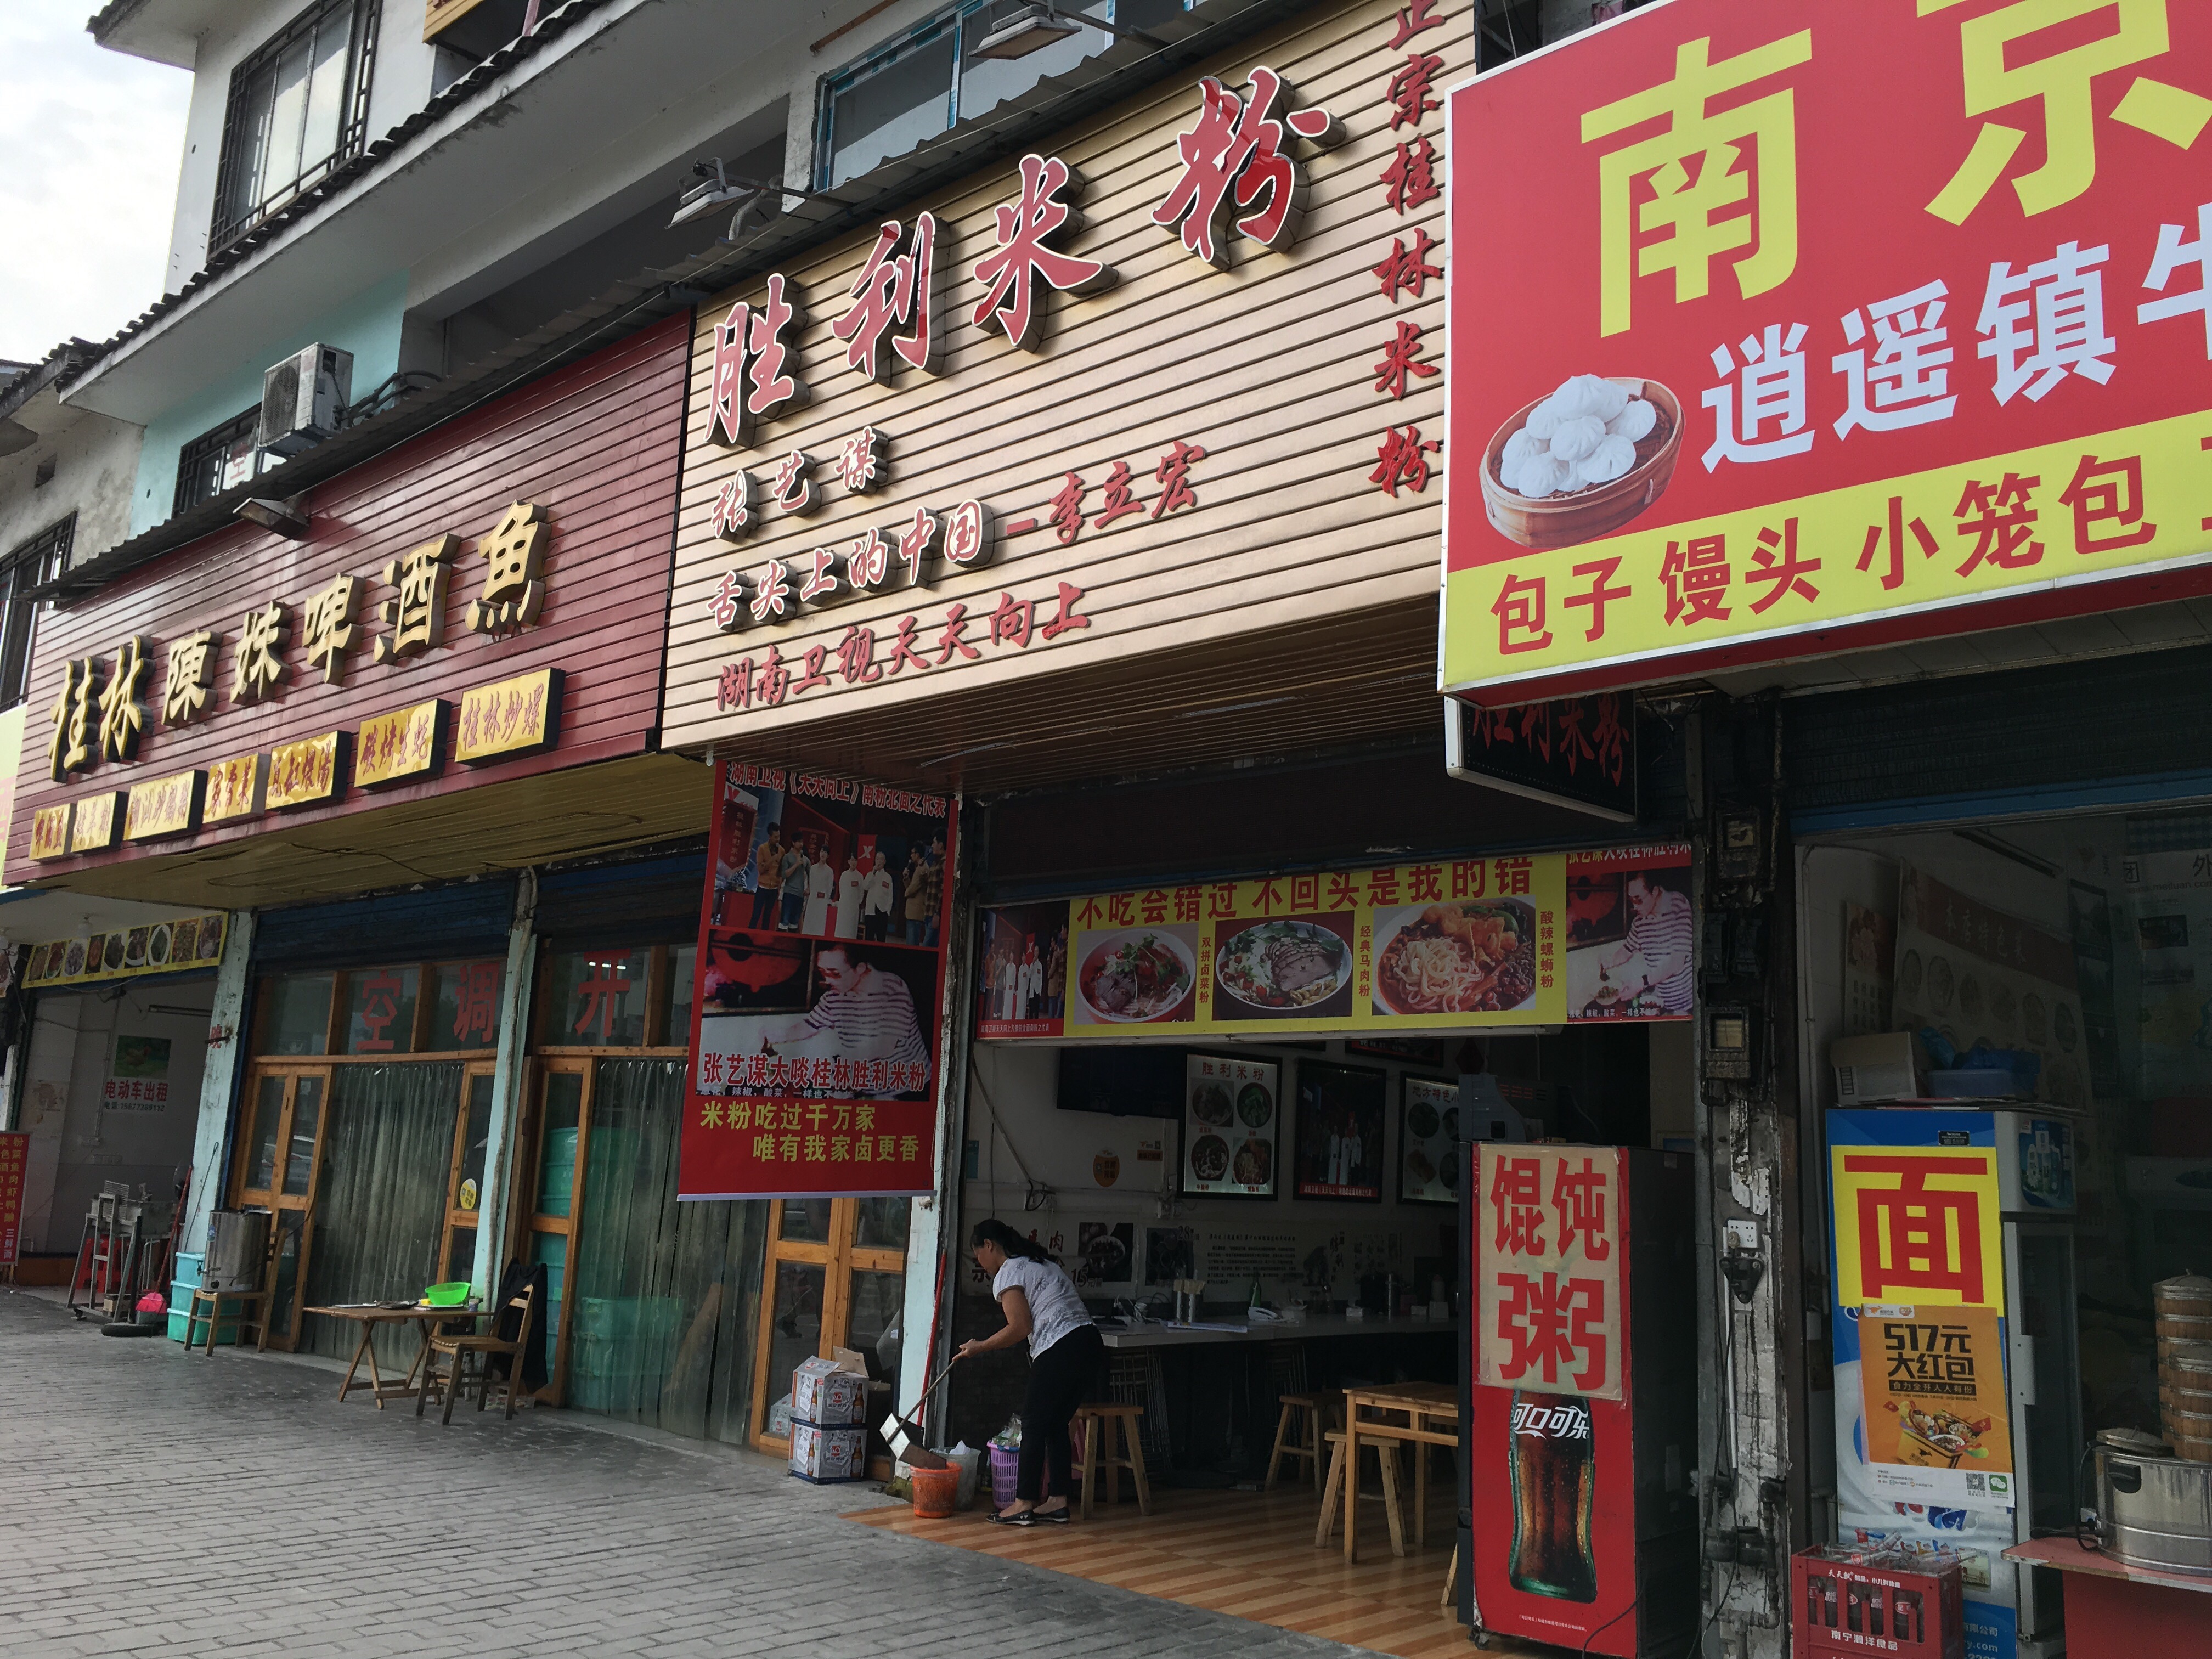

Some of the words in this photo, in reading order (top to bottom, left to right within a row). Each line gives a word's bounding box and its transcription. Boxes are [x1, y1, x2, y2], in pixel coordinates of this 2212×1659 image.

[1580, 0, 2212, 338] 南京
[703, 65, 1339, 445] 胜利米粉
[1370, 0, 1445, 499] 正宗桂林米粉
[710, 425, 888, 541] 张艺谋
[707, 499, 992, 631] 舌尖上的中国
[1490, 555, 1631, 655] 包子
[1658, 517, 1822, 626] 馒头
[1855, 454, 2158, 591] 小笼包
[716, 582, 1091, 710] 湖南卫视天天向上
[462, 683, 544, 751] 桂林炒螺
[1077, 883, 1237, 930] 不吃会错过
[1251, 857, 1533, 916] 不回头是我的错
[1199, 936, 1211, 1004] 双拼卤菜粉
[1358, 925, 1372, 997] 经典马肉粉
[1540, 911, 1554, 988] 酸辣螺蛳粉
[105, 1079, 168, 1102] 电动车出租
[704, 1052, 926, 1092] 张艺谋大啖桂林胜利米粉
[1201, 1062, 1265, 1081] 胜利米粉
[701, 1101, 876, 1131] 米粉吃过千万家
[753, 1134, 919, 1162] 唯有我家卤更香
[1491, 1154, 1610, 1262] 馄饨
[1844, 1155, 1987, 1304] 面
[1498, 1272, 1606, 1391] 粥
[1884, 1323, 1971, 1353] 517元
[1887, 1352, 1974, 1381] 大红包
[1513, 1403, 1589, 1440] 可口可乐
[1893, 1382, 1972, 1393] 食力全开人人有份
